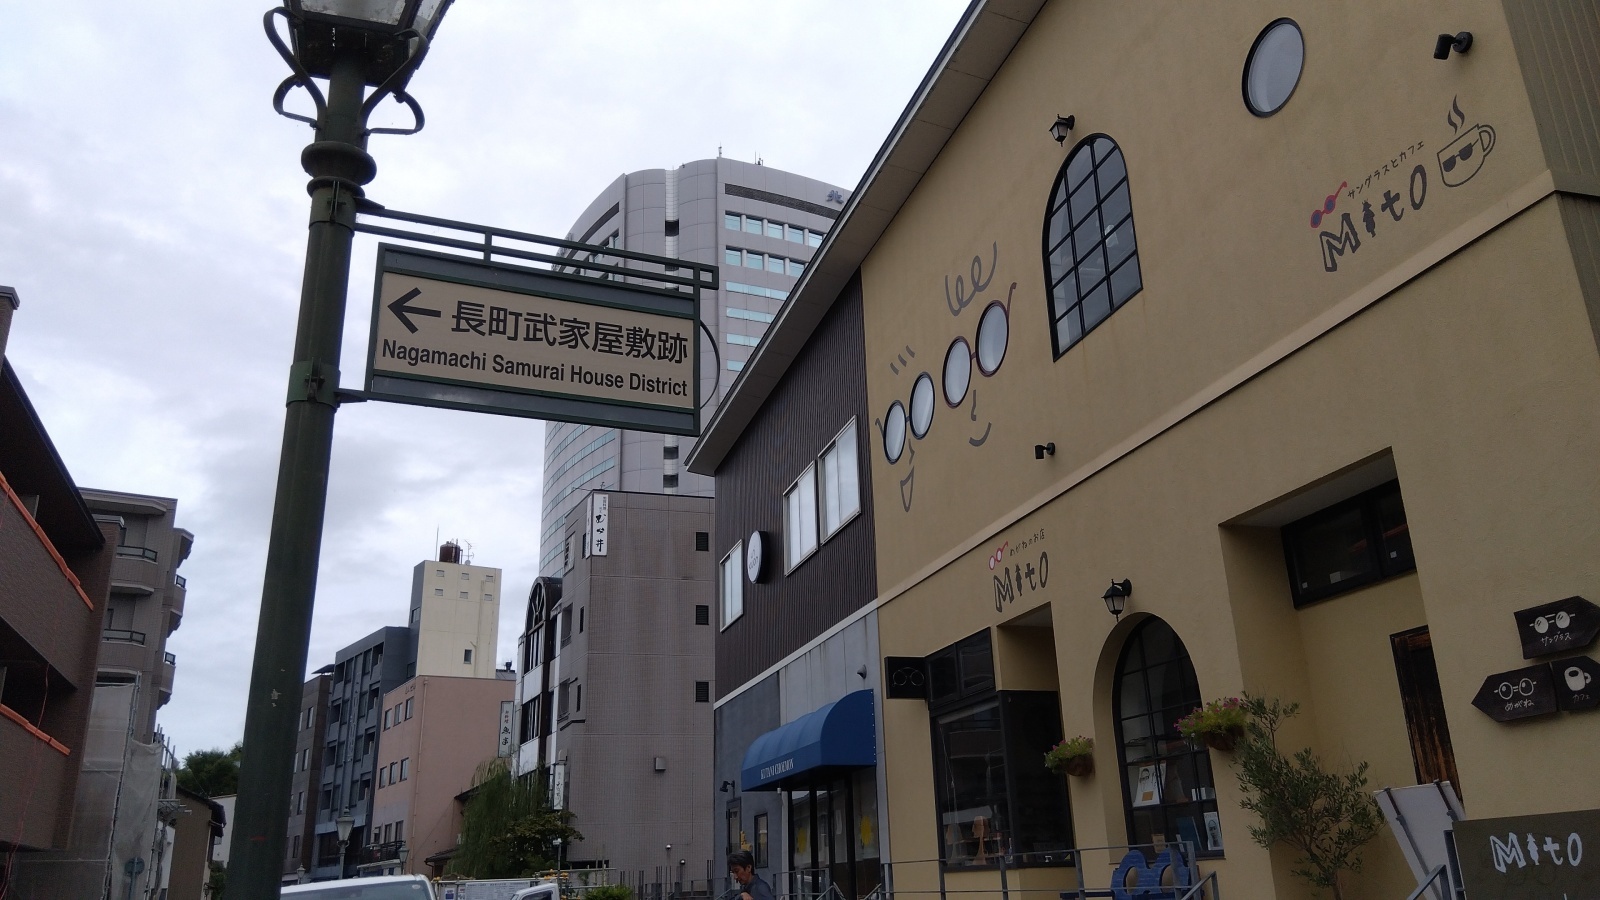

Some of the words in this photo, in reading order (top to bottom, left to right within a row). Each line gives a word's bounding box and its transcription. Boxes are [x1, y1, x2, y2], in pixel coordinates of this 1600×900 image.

[1347, 141, 1425, 200] サングラスとカフェ
[451, 300, 689, 364] 長町武家屋敷跡
[382, 338, 487, 372] Nagamachi
[492, 353, 565, 382] Samurai
[570, 365, 625, 389] House
[629, 373, 688, 397] District
[1540, 631, 1572, 647] サングラス
[1504, 698, 1535, 712] めがね
